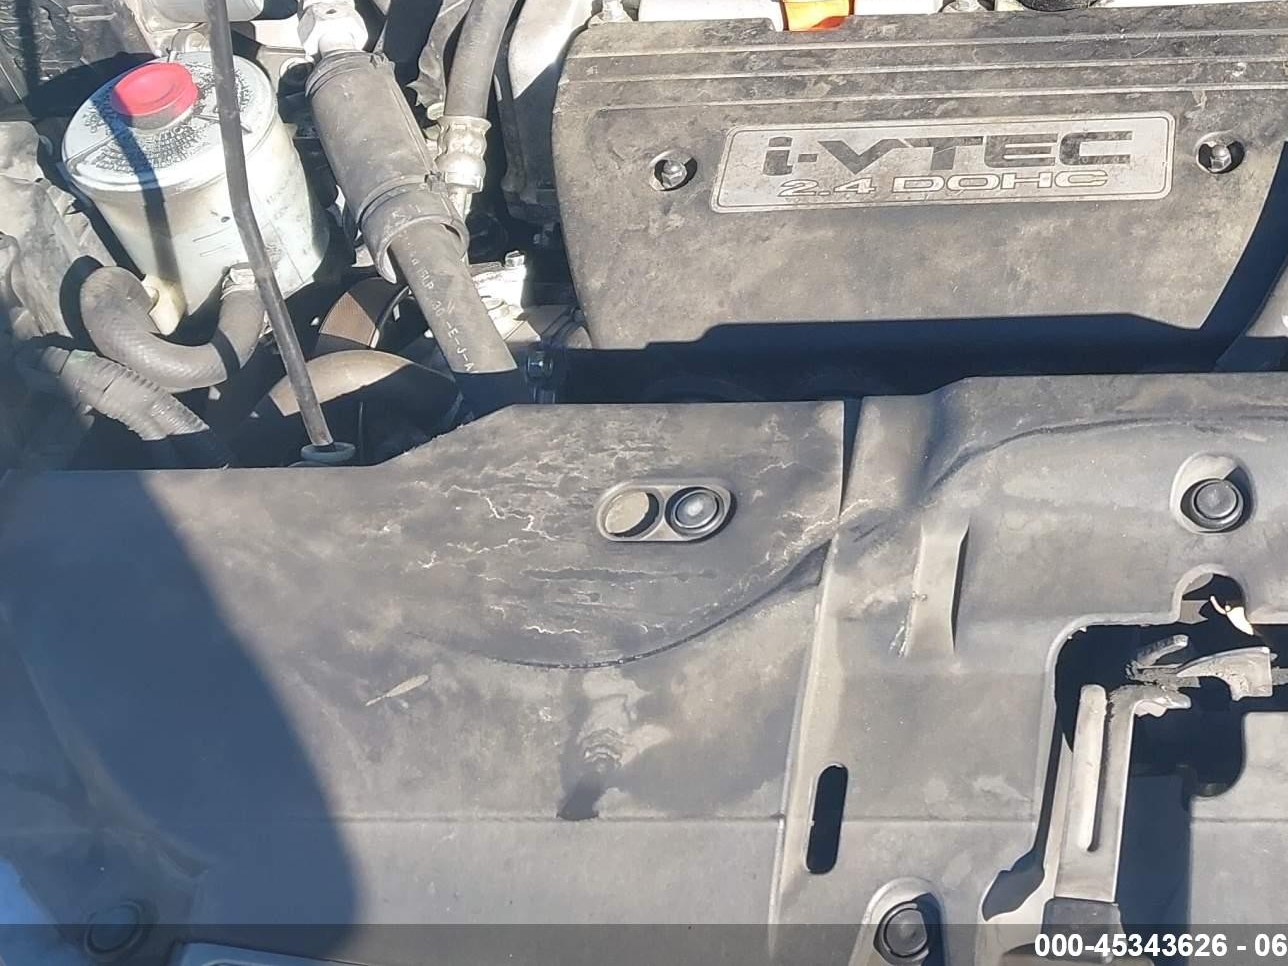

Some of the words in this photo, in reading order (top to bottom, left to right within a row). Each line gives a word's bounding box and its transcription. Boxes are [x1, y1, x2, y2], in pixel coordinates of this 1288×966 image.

[763, 131, 1133, 176] i-VTEC
[778, 176, 876, 197] 2.4
[891, 169, 1109, 194] DOHC
